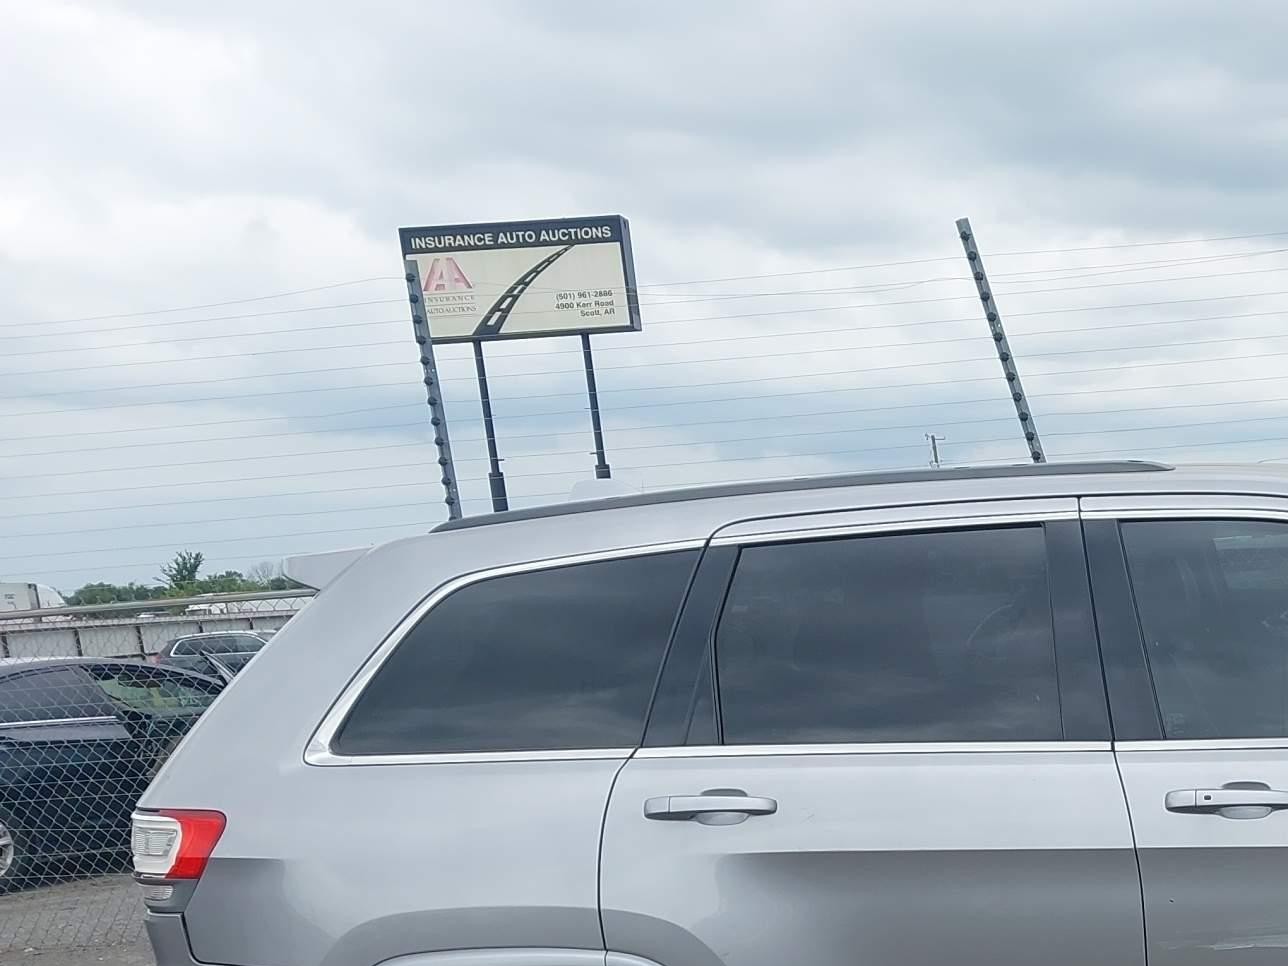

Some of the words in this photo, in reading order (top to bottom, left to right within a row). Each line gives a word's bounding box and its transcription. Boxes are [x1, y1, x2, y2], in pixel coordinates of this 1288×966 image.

[411, 233, 494, 249] INSURANCE
[497, 230, 536, 244] AUTO
[540, 226, 612, 242] AUCTIONS
[425, 295, 475, 303] INSURANCE
[556, 292, 575, 302] (501)
[555, 302, 574, 310] 4900
[594, 299, 614, 307] Road
